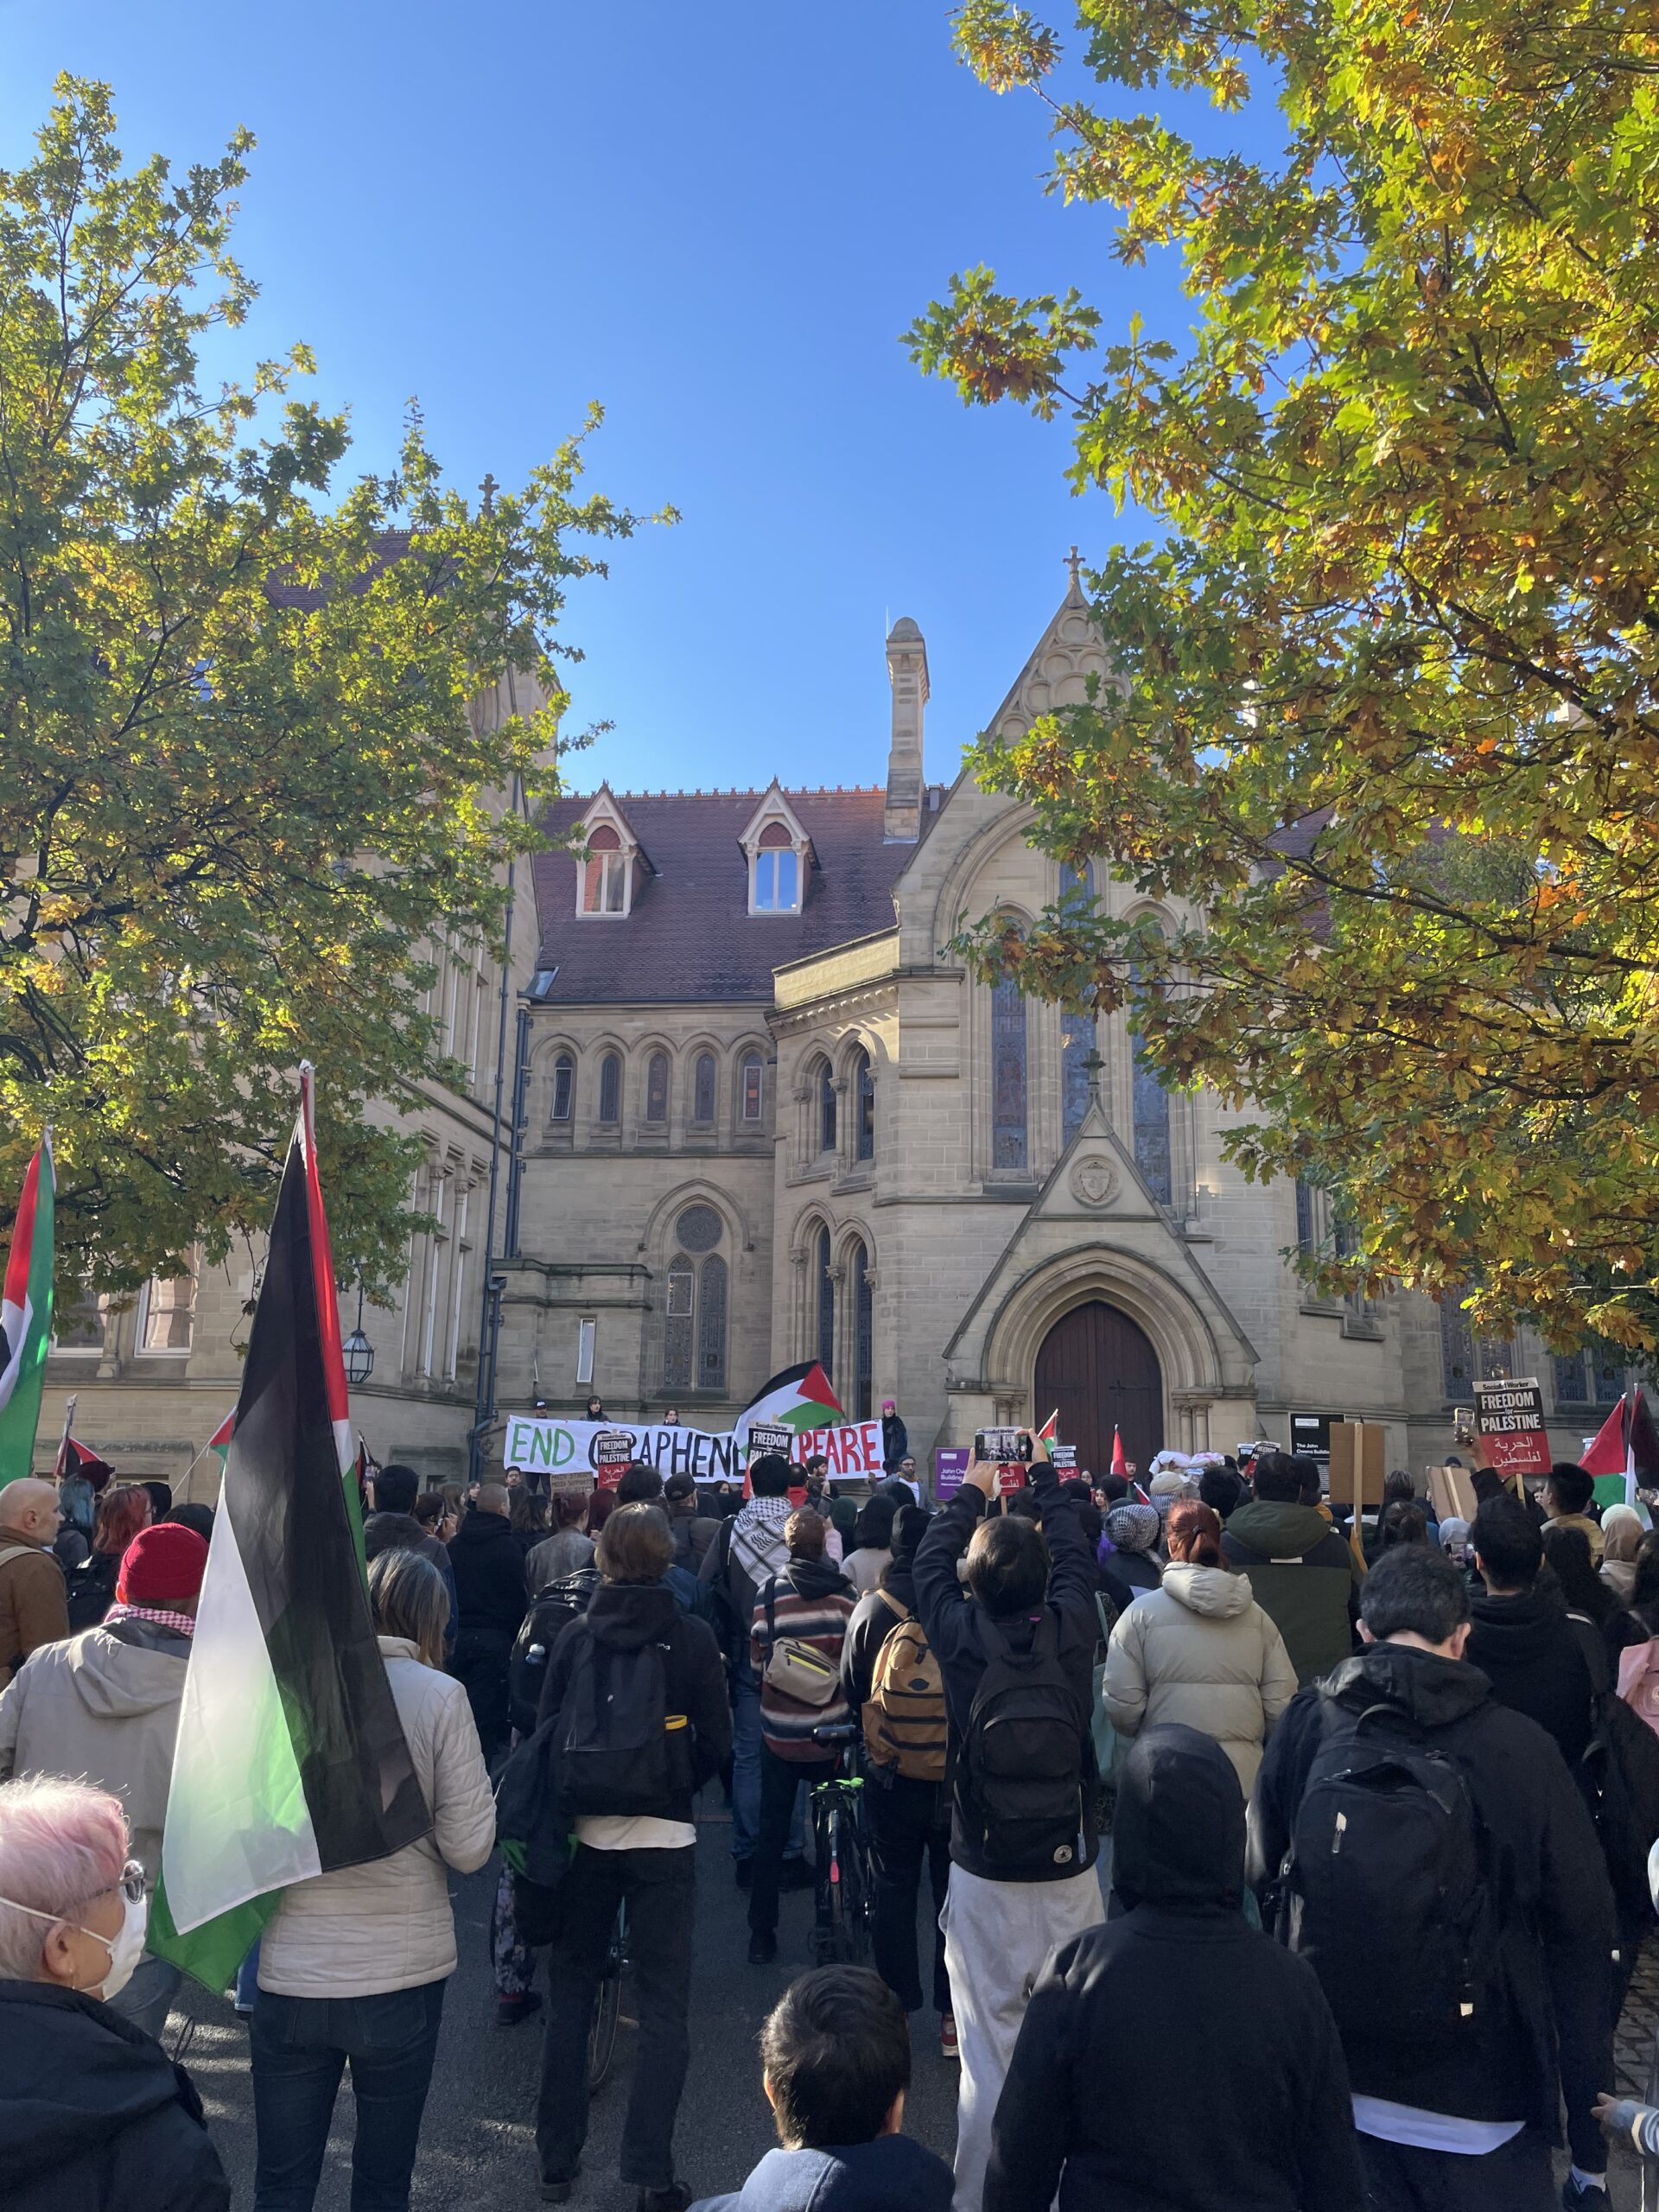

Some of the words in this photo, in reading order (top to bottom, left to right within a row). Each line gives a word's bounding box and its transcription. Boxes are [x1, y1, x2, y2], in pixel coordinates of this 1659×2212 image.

[1481, 1392, 1535, 1409] FREEDOM
[1481, 1414, 1541, 1432] PALESTINE
[511, 1424, 575, 1466] END
[601, 1440, 628, 1451] FREEDOM
[753, 1431, 788, 1447] FREEDOM
[1495, 1436, 1533, 1452] الحرية
[599, 1453, 630, 1464] PALESTINE
[1492, 1451, 1541, 1467] لفلسطين
